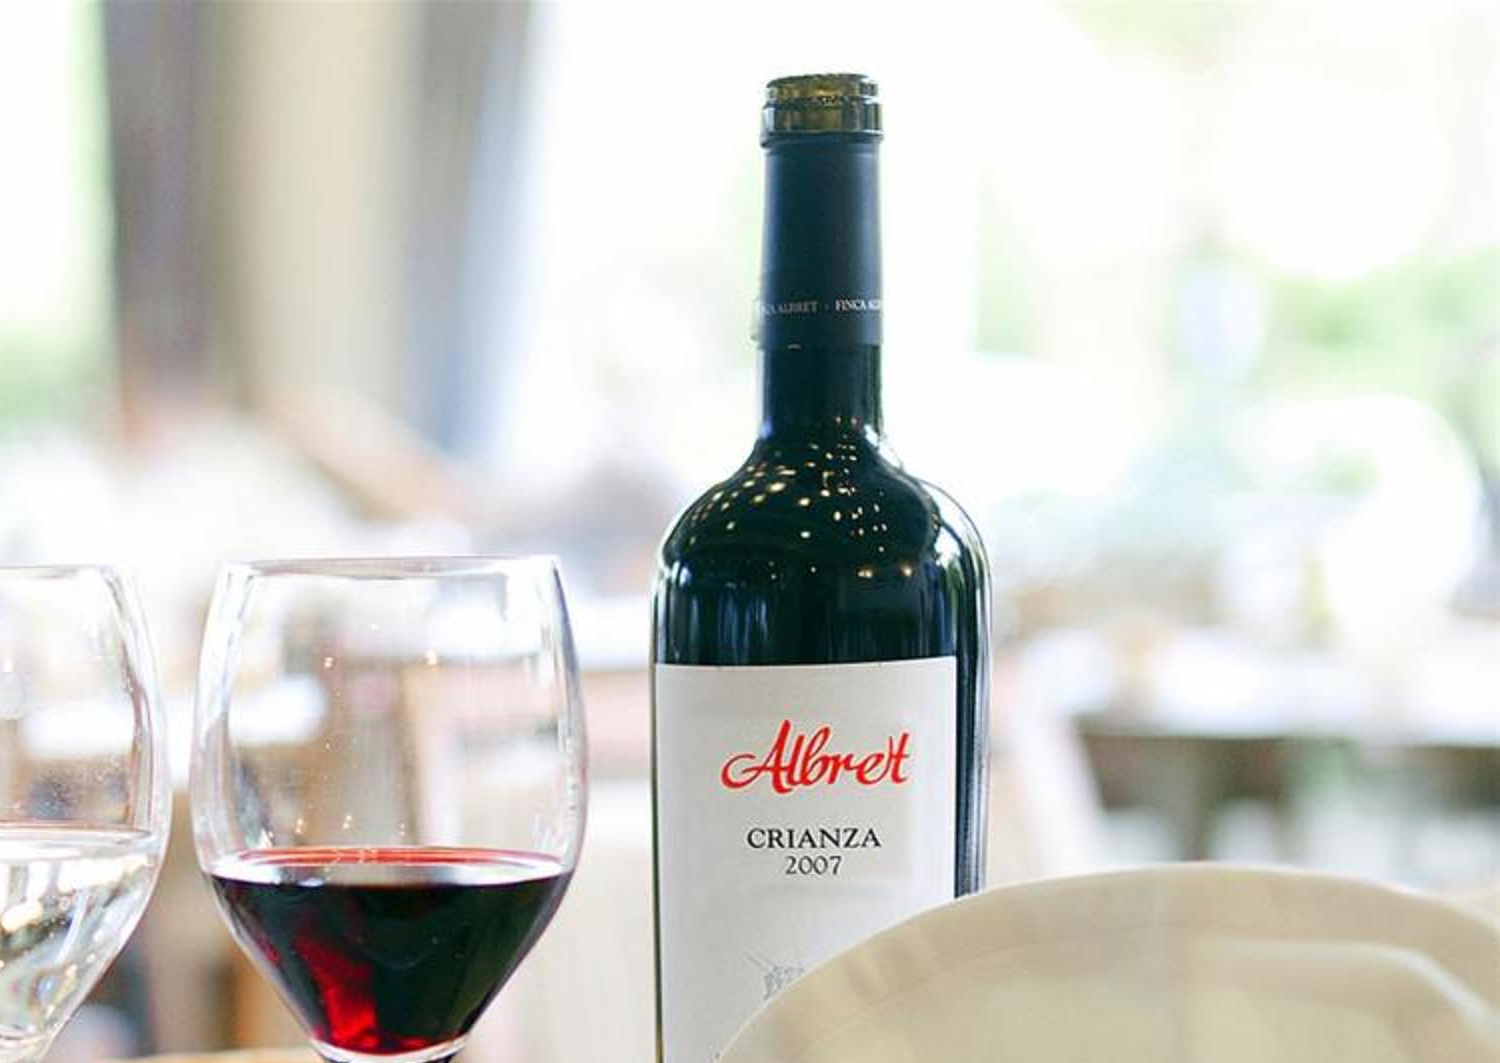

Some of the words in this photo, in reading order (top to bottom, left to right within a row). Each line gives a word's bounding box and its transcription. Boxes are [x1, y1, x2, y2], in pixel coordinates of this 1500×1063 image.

[835, 299, 866, 311] FINCA
[720, 719, 911, 795] Albret
[747, 827, 881, 850] CRIANZA
[785, 855, 842, 875] 2007
